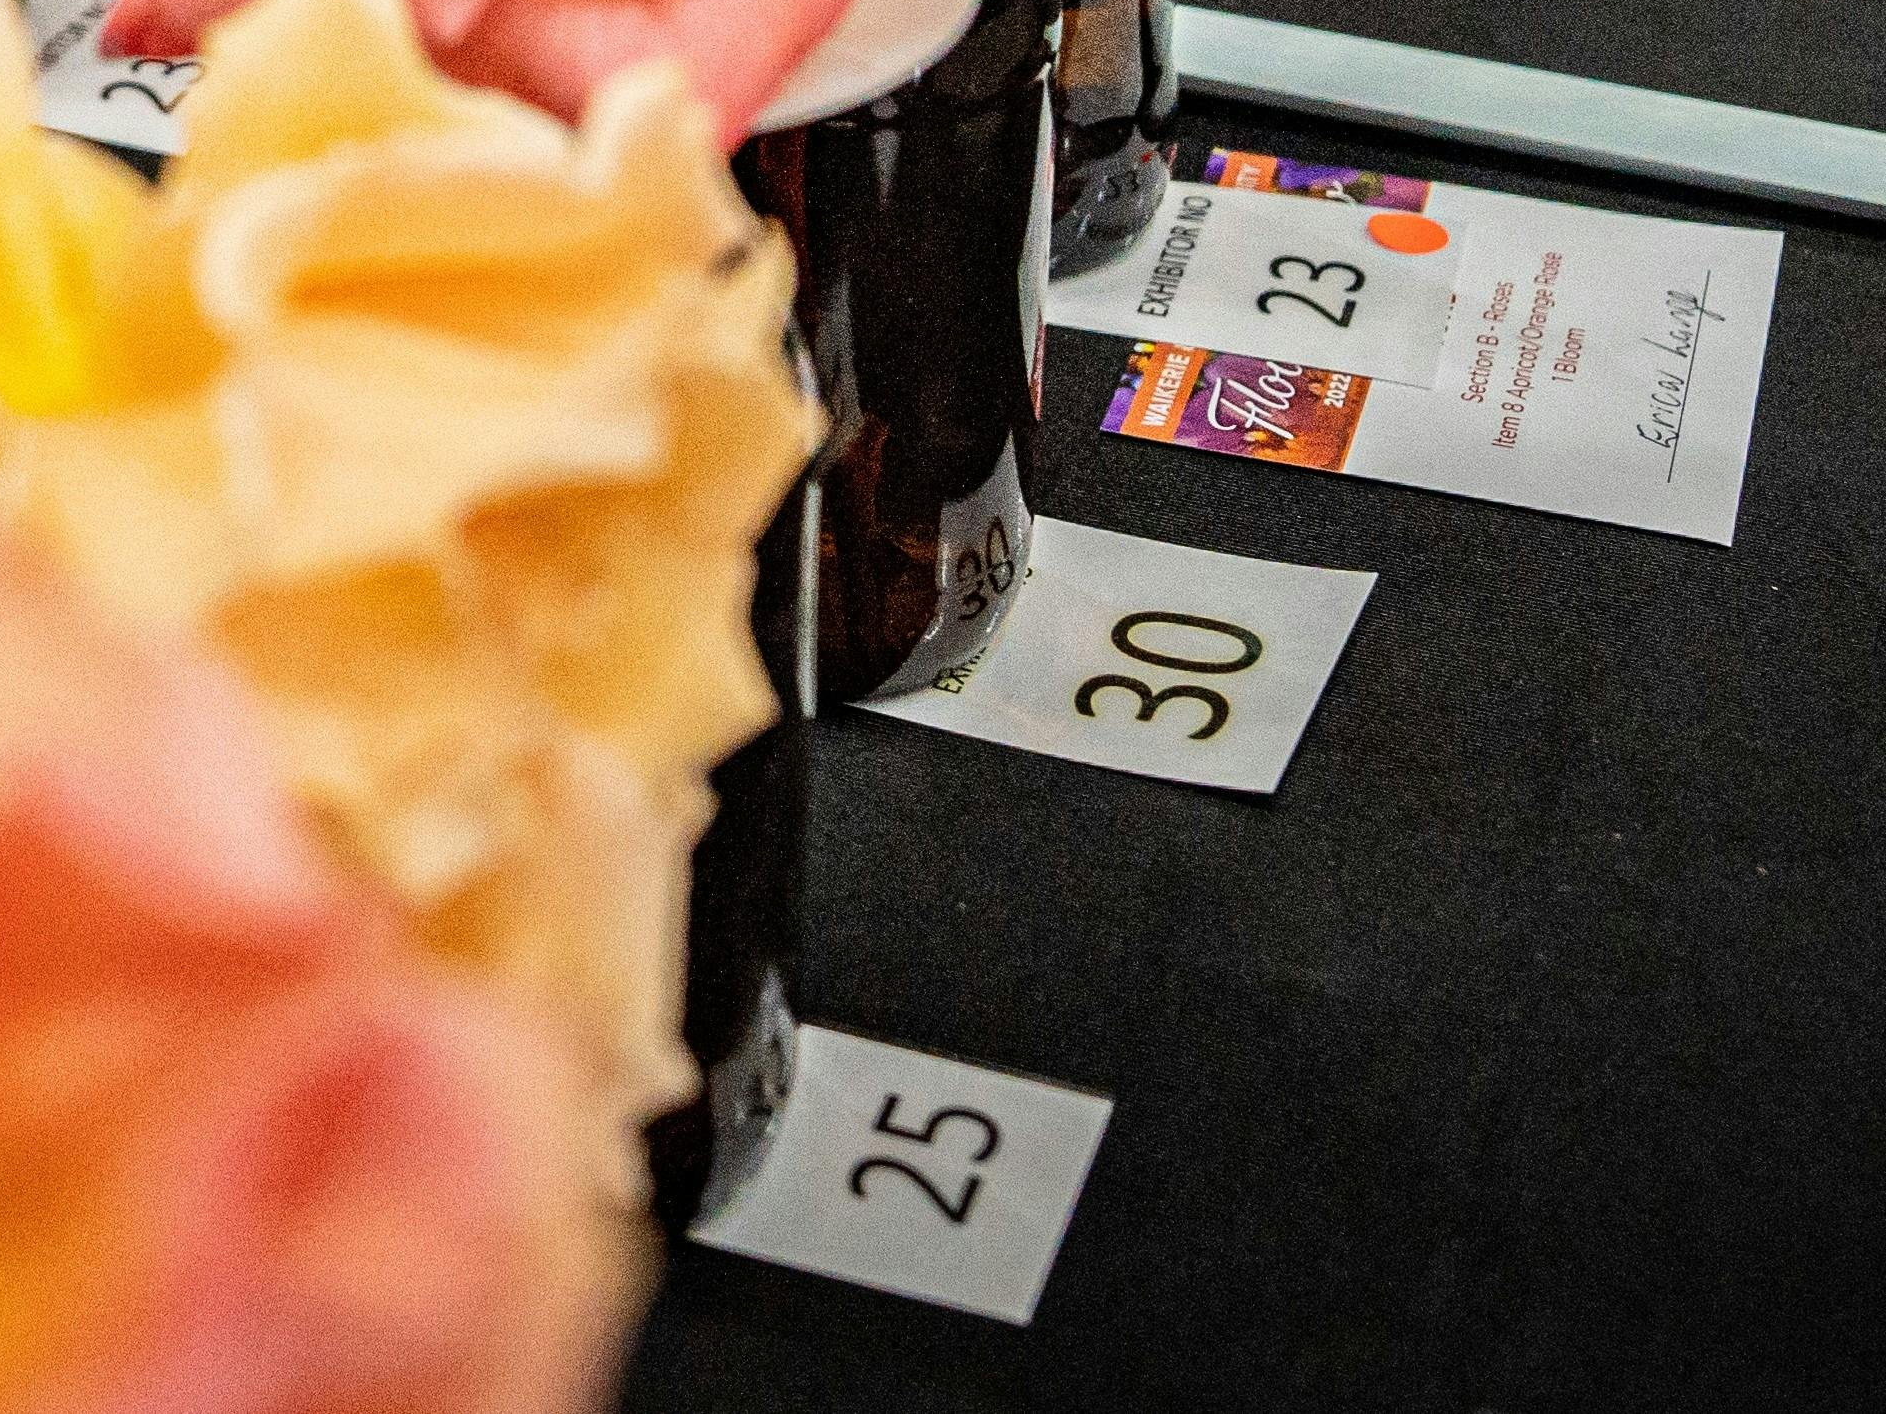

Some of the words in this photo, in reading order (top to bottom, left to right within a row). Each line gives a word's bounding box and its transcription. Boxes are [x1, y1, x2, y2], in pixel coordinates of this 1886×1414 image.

[1136, 225, 1202, 317] EXHIBITOR
[1178, 195, 1212, 223] NO
[1534, 251, 1563, 285] Rose
[1256, 254, 1366, 329] 23
[1483, 281, 1514, 322] Roses
[1476, 334, 1499, 346] B
[1506, 288, 1556, 401] Apricot/Orange
[1554, 327, 1586, 374] Bloom
[1140, 353, 1191, 428] WAIKERIE
[1460, 348, 1495, 403] Section
[1551, 375, 1574, 383] 1
[1491, 416, 1521, 449] Item
[1501, 402, 1525, 413] 8
[1073, 609, 1265, 743] 30
[849, 1093, 1003, 1225] 25
